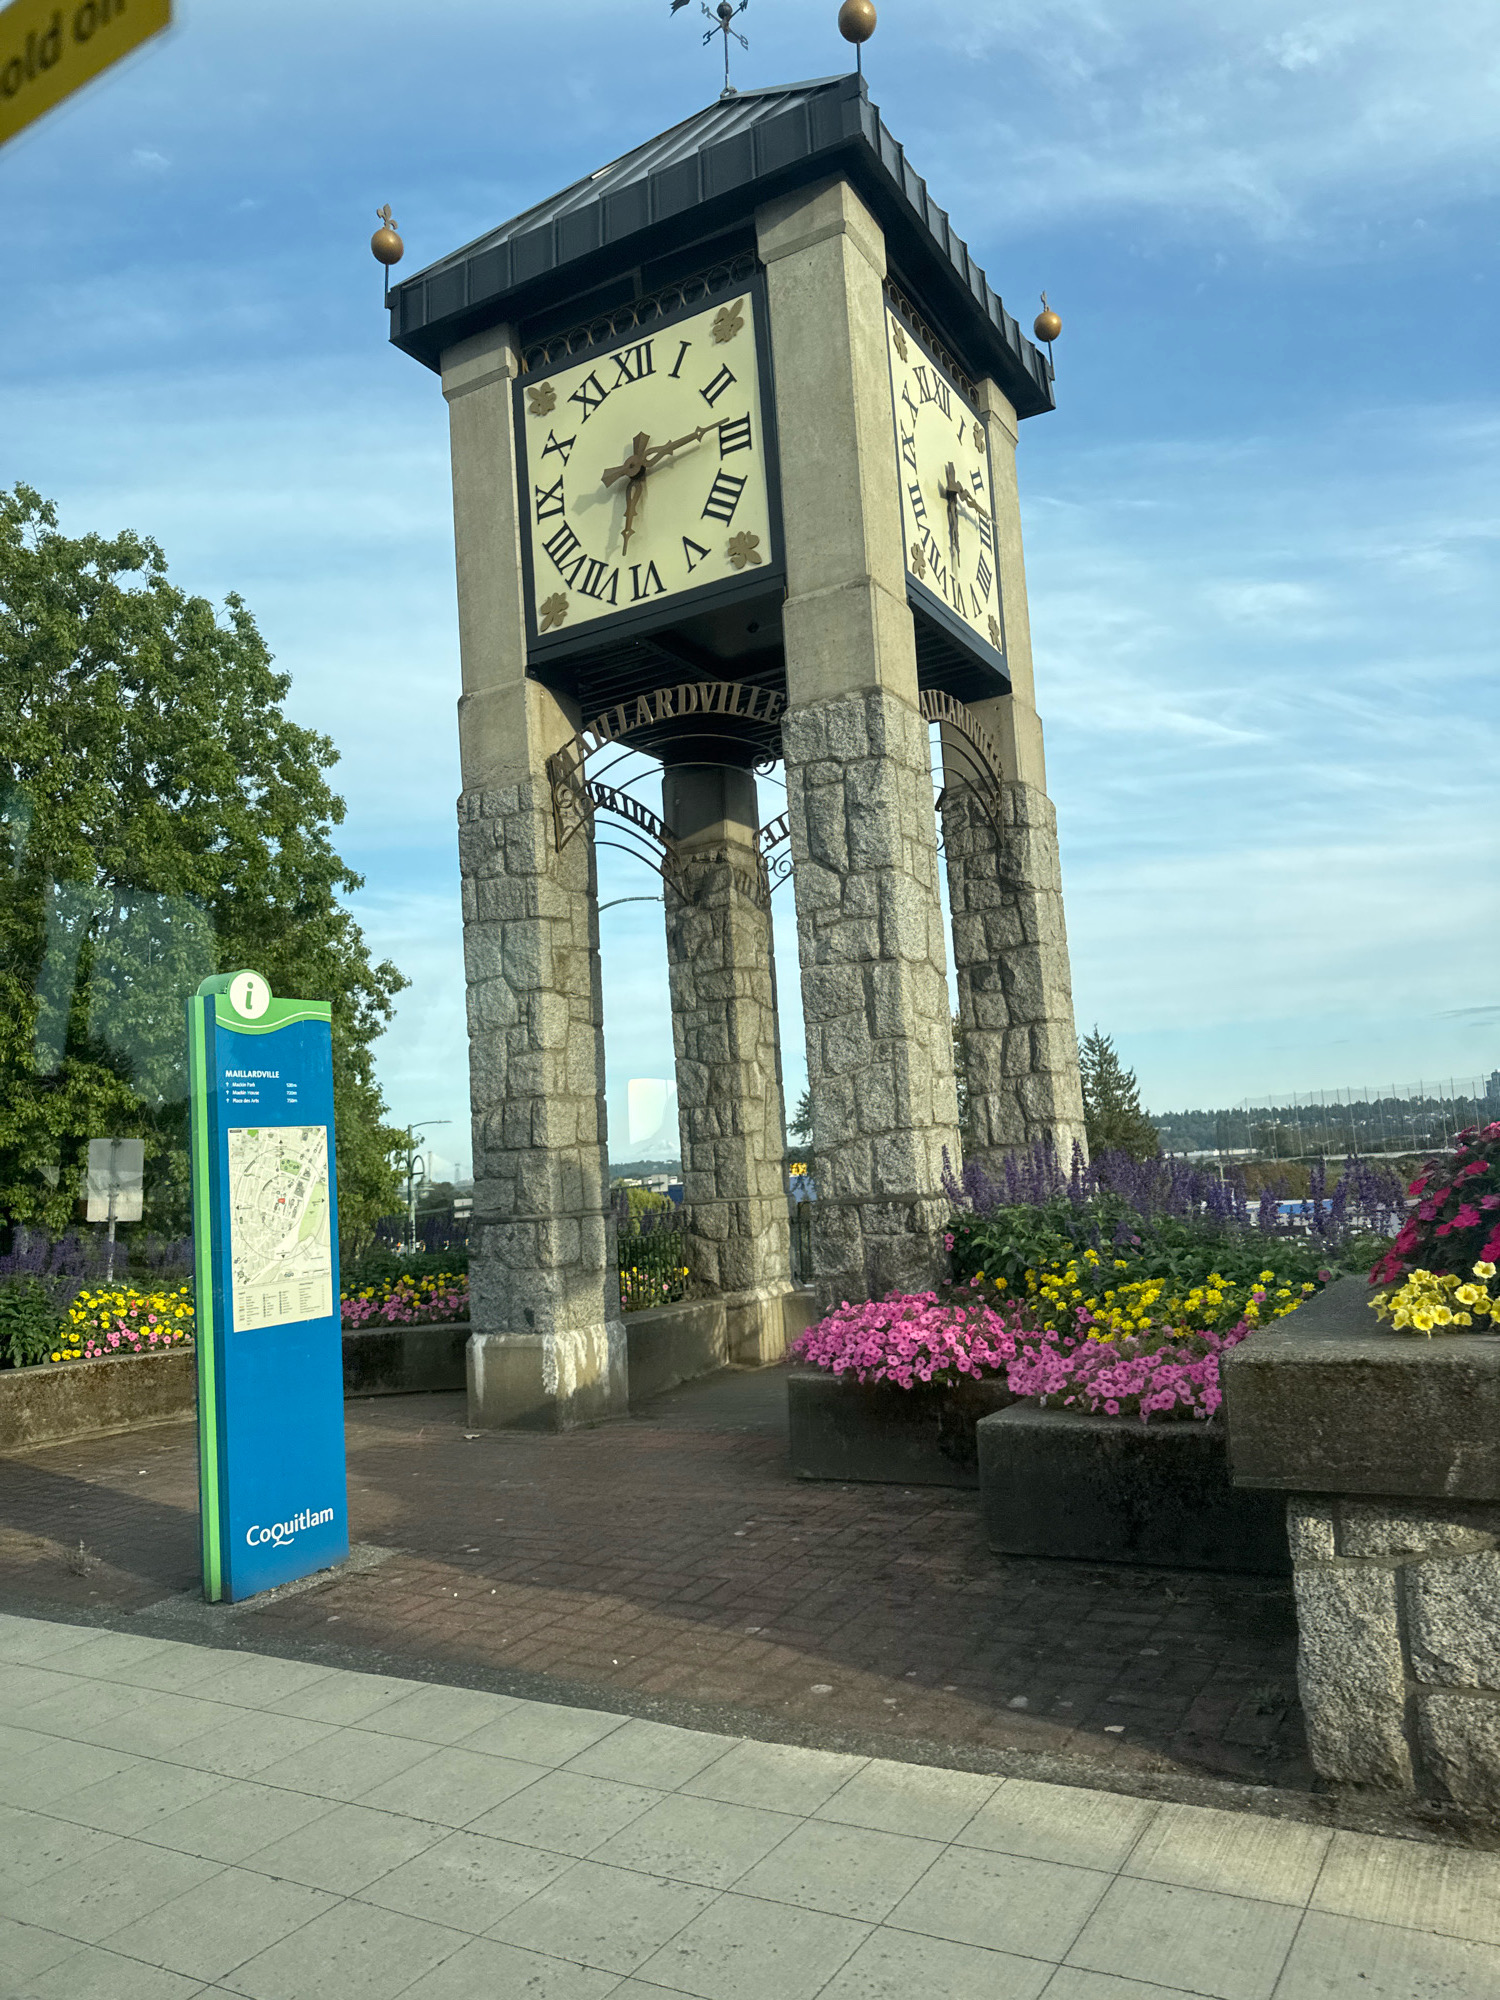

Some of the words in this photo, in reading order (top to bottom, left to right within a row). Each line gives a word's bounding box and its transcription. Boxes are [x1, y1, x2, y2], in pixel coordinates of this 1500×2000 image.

[610, 339, 656, 391] XII
[668, 341, 691, 378] I
[567, 370, 611, 424] XI
[699, 363, 737, 408] II
[541, 429, 577, 466] X
[719, 411, 752, 460] III
[536, 475, 565, 524] IX
[701, 468, 748, 527] IIII
[542, 520, 587, 589] VIII
[682, 536, 711, 573] V
[577, 558, 619, 605] VII
[629, 560, 667, 602] VI
[550, 682, 786, 785] MAILLARDVILLE
[919, 689, 1003, 778] AILLARDVILLE
[225, 1070, 280, 1079] MAILLARDVILLE
